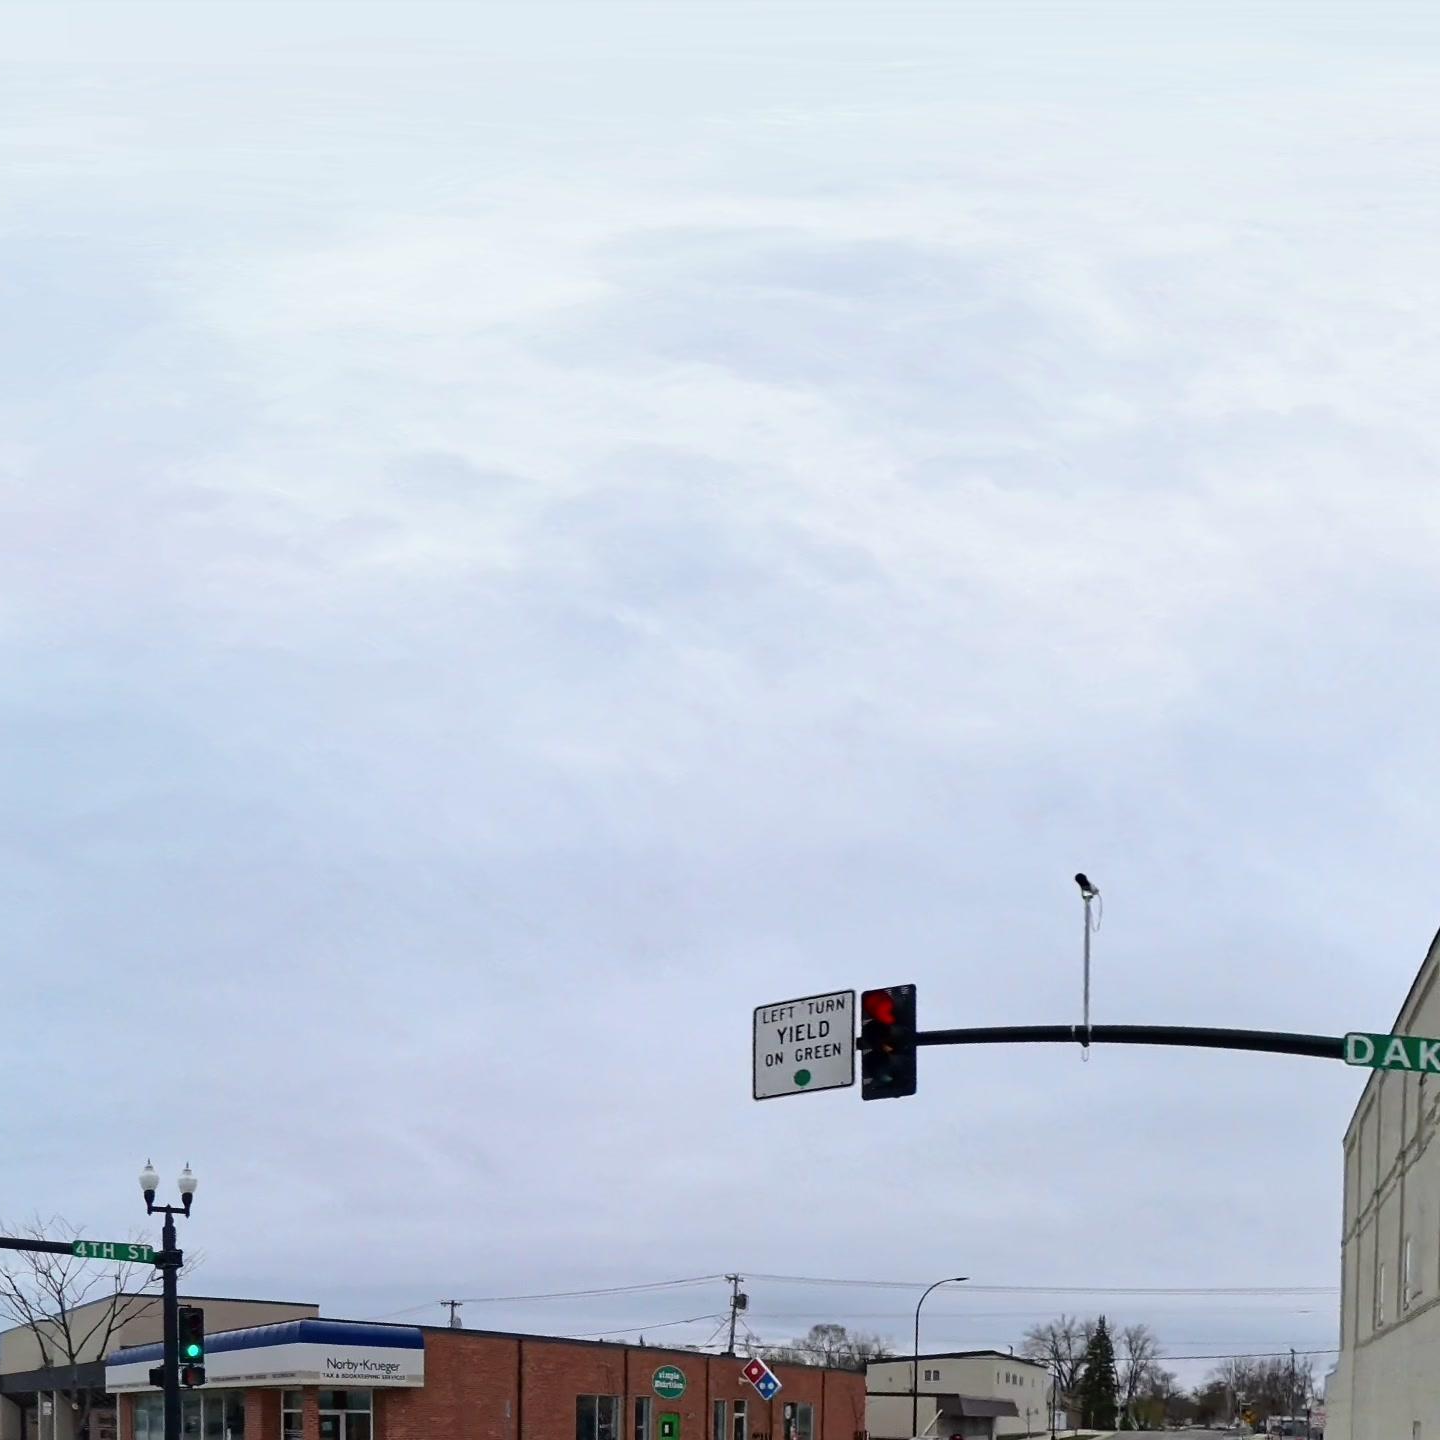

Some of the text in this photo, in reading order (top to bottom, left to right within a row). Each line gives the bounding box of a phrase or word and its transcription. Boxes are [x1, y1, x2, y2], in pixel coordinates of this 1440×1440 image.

[763, 996, 845, 1024] LEFT TURN
[777, 1020, 830, 1044] YIELD
[765, 1042, 841, 1067] ON GREEN
[76, 1241, 151, 1260] 4TH ST
